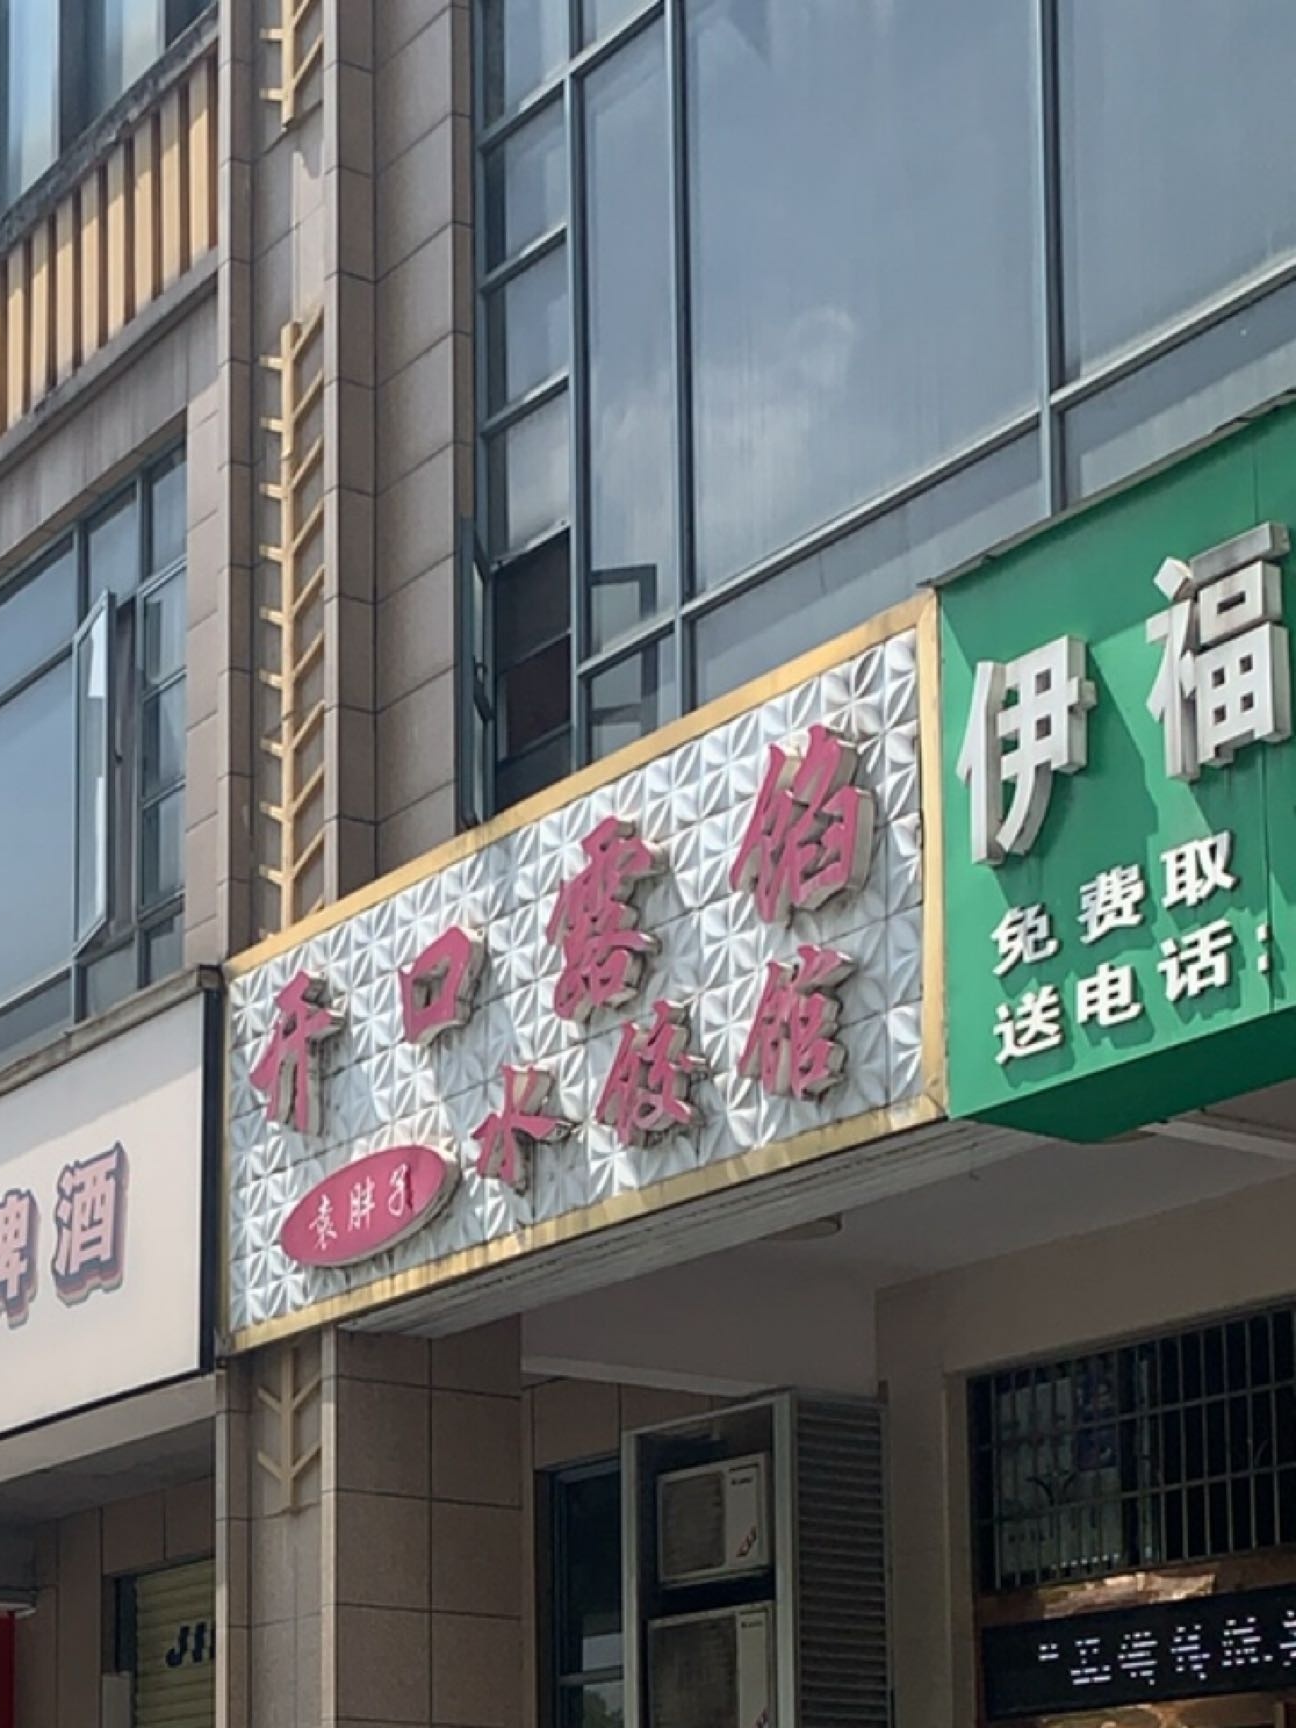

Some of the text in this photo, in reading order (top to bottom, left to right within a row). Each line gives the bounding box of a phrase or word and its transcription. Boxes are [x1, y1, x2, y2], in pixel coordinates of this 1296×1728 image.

[956, 521, 1291, 866] 伊福
[990, 829, 1237, 976] 免费取
[471, 944, 849, 1190] 水饺馆
